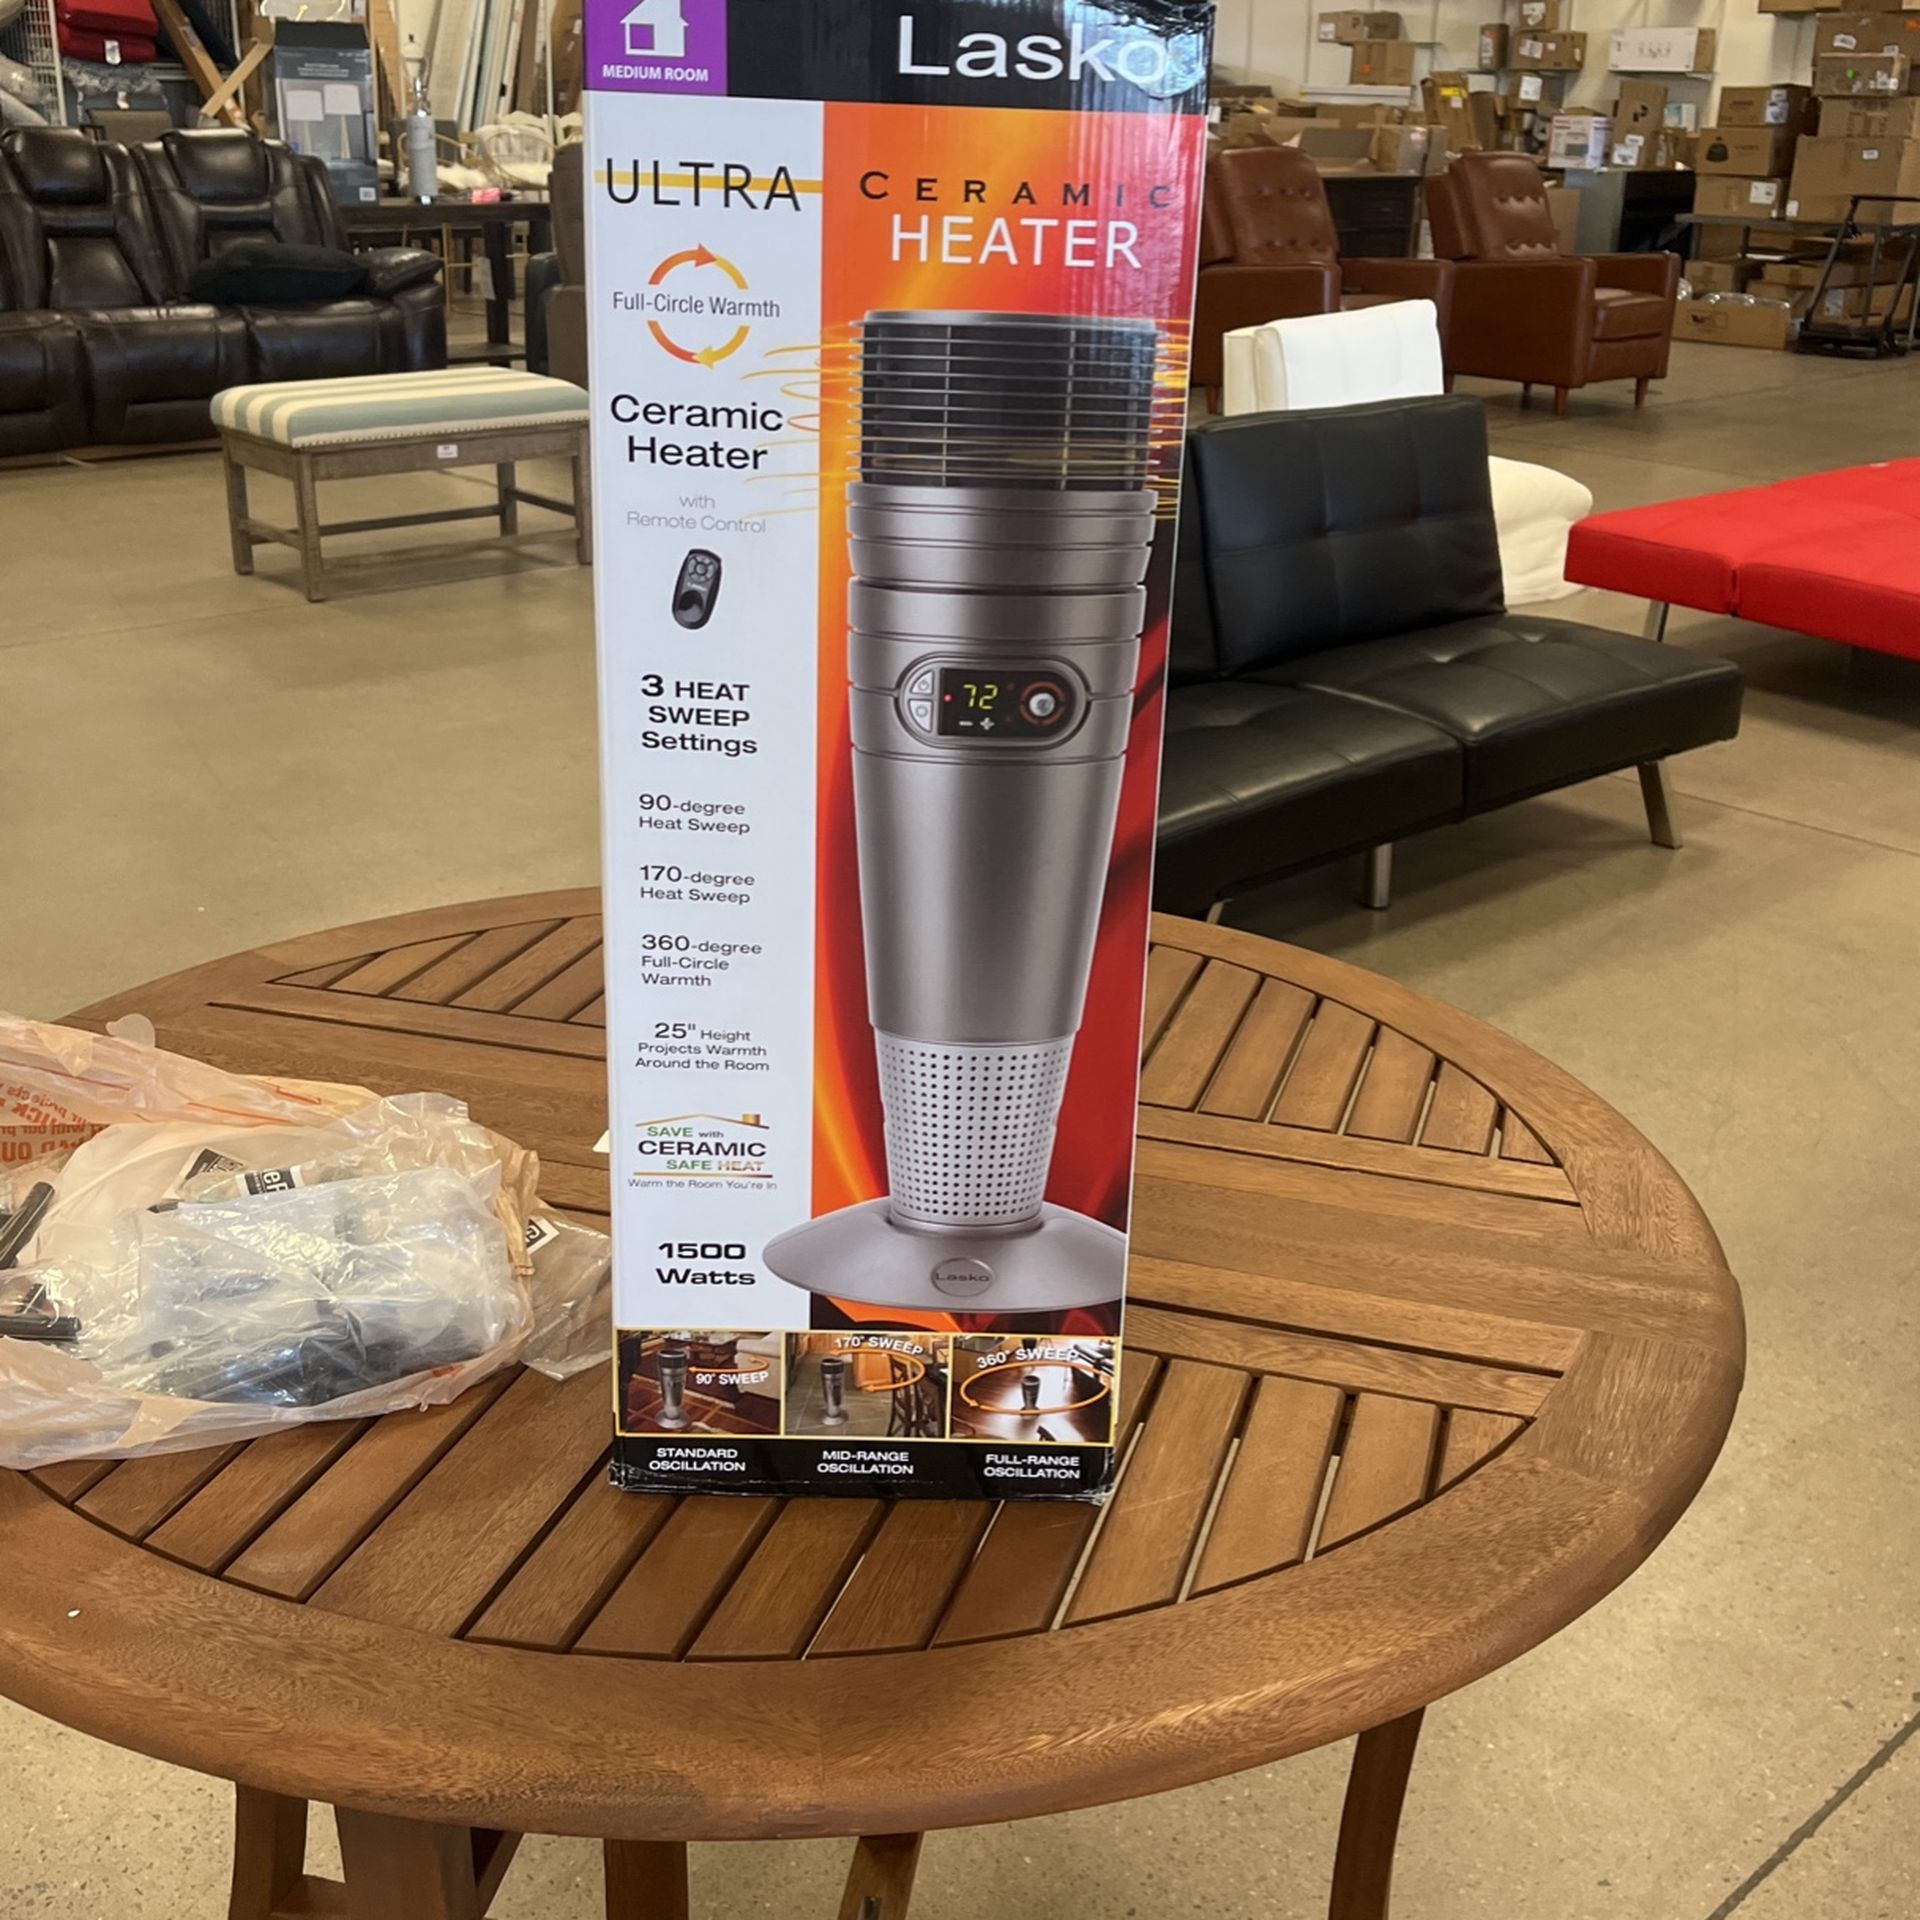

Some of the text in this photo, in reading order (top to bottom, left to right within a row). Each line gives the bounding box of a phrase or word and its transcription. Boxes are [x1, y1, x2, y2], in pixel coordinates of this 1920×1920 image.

[899, 15, 1168, 83] Lasko
[602, 64, 709, 82] MEDIUM ROOM
[606, 158, 801, 212] ULTRA
[859, 171, 1171, 209] CERAMIC
[891, 213, 1142, 268] HEATER
[613, 291, 780, 318] Full-Circle Warmth
[610, 394, 783, 432] Ceramic
[628, 435, 768, 470] Heater
[680, 495, 716, 509] with
[627, 511, 766, 533] Remote Control
[641, 673, 750, 701] 3 HEAT
[962, 684, 998, 709] 72
[648, 705, 750, 727] SWEEP
[641, 730, 758, 757] Settings
[639, 793, 746, 817] 90-degree
[639, 816, 751, 836] Heat Sweep
[640, 864, 755, 887] 170-degree
[640, 887, 750, 906] Heat Sweep
[641, 934, 762, 956] 360-degree
[641, 955, 729, 970] Full-Circle
[641, 972, 712, 987] Warmth
[654, 1022, 751, 1044] 25" Height
[637, 1042, 767, 1057] Projects Warmth
[635, 1057, 770, 1071] Around the Room
[647, 1126, 724, 1139] SAVE with
[638, 1140, 767, 1157] CERAMIC
[666, 1159, 764, 1172] SAFE HEAT
[628, 1178, 663, 1188] Warm
[666, 1179, 685, 1188] the
[688, 1179, 723, 1189] Room
[766, 1181, 777, 1190] In
[658, 1243, 746, 1259] 1500
[655, 1268, 756, 1285] Watts
[936, 1273, 990, 1282] Lasko
[868, 1336, 923, 1356] SWEEP
[1015, 1348, 1079, 1362] SWEEP
[719, 1371, 769, 1385] SWEEP
[656, 1448, 738, 1459] STANDARD
[822, 1450, 909, 1462] MID-RANGE
[985, 1454, 1080, 1467] FULL-RANGE
[649, 1460, 746, 1472] OSCILLATION
[817, 1462, 914, 1475] OSCILLATION
[984, 1466, 1080, 1479] OSCILLATION
